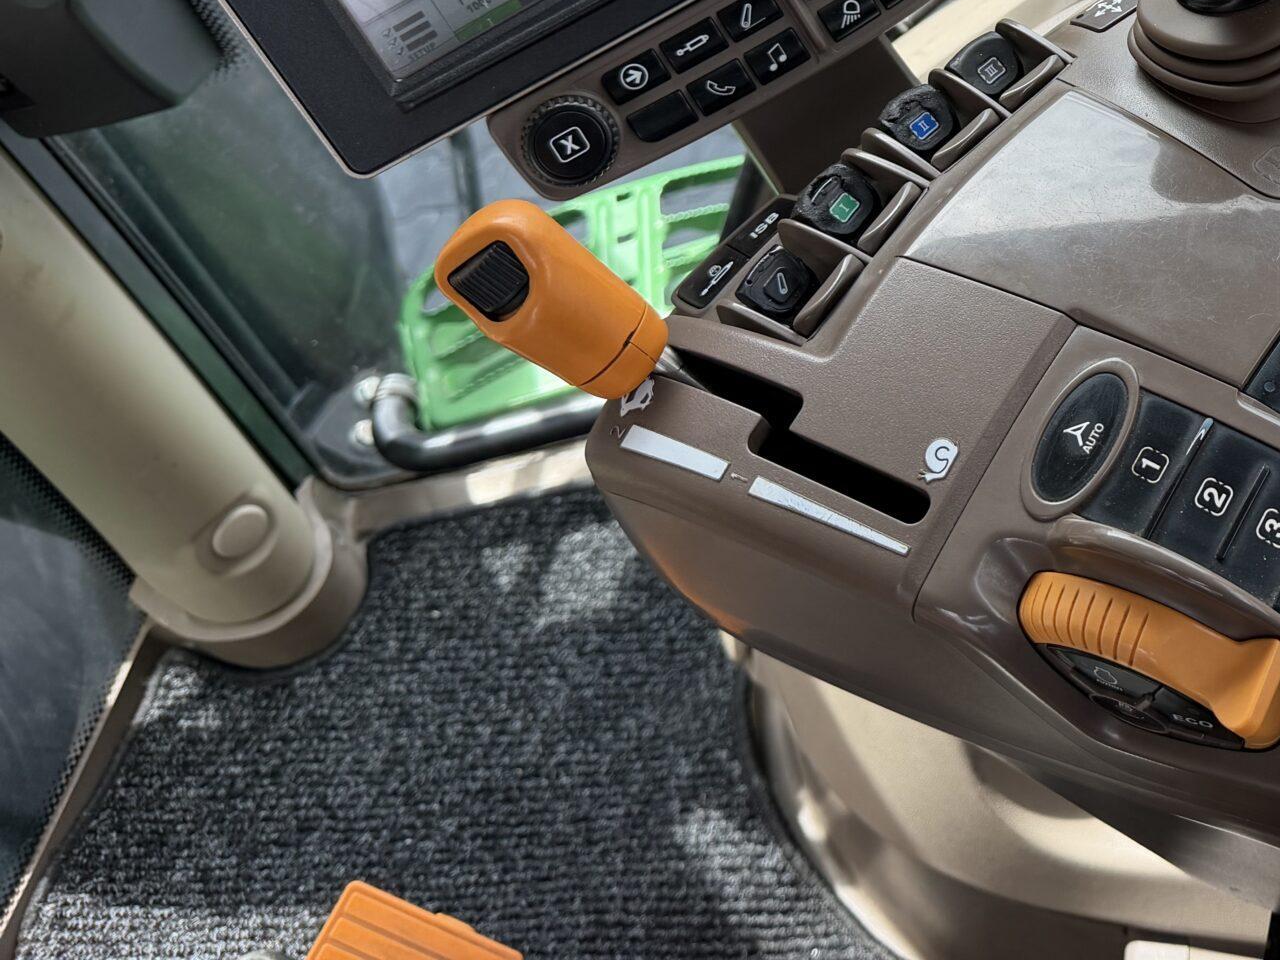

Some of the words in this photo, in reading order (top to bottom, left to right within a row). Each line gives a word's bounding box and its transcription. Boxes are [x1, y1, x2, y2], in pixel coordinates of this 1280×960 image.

[1081, 423, 1105, 454] AUTO
[1140, 457, 1161, 473] 1
[1202, 487, 1227, 507] 2
[1172, 712, 1214, 729] ECO
